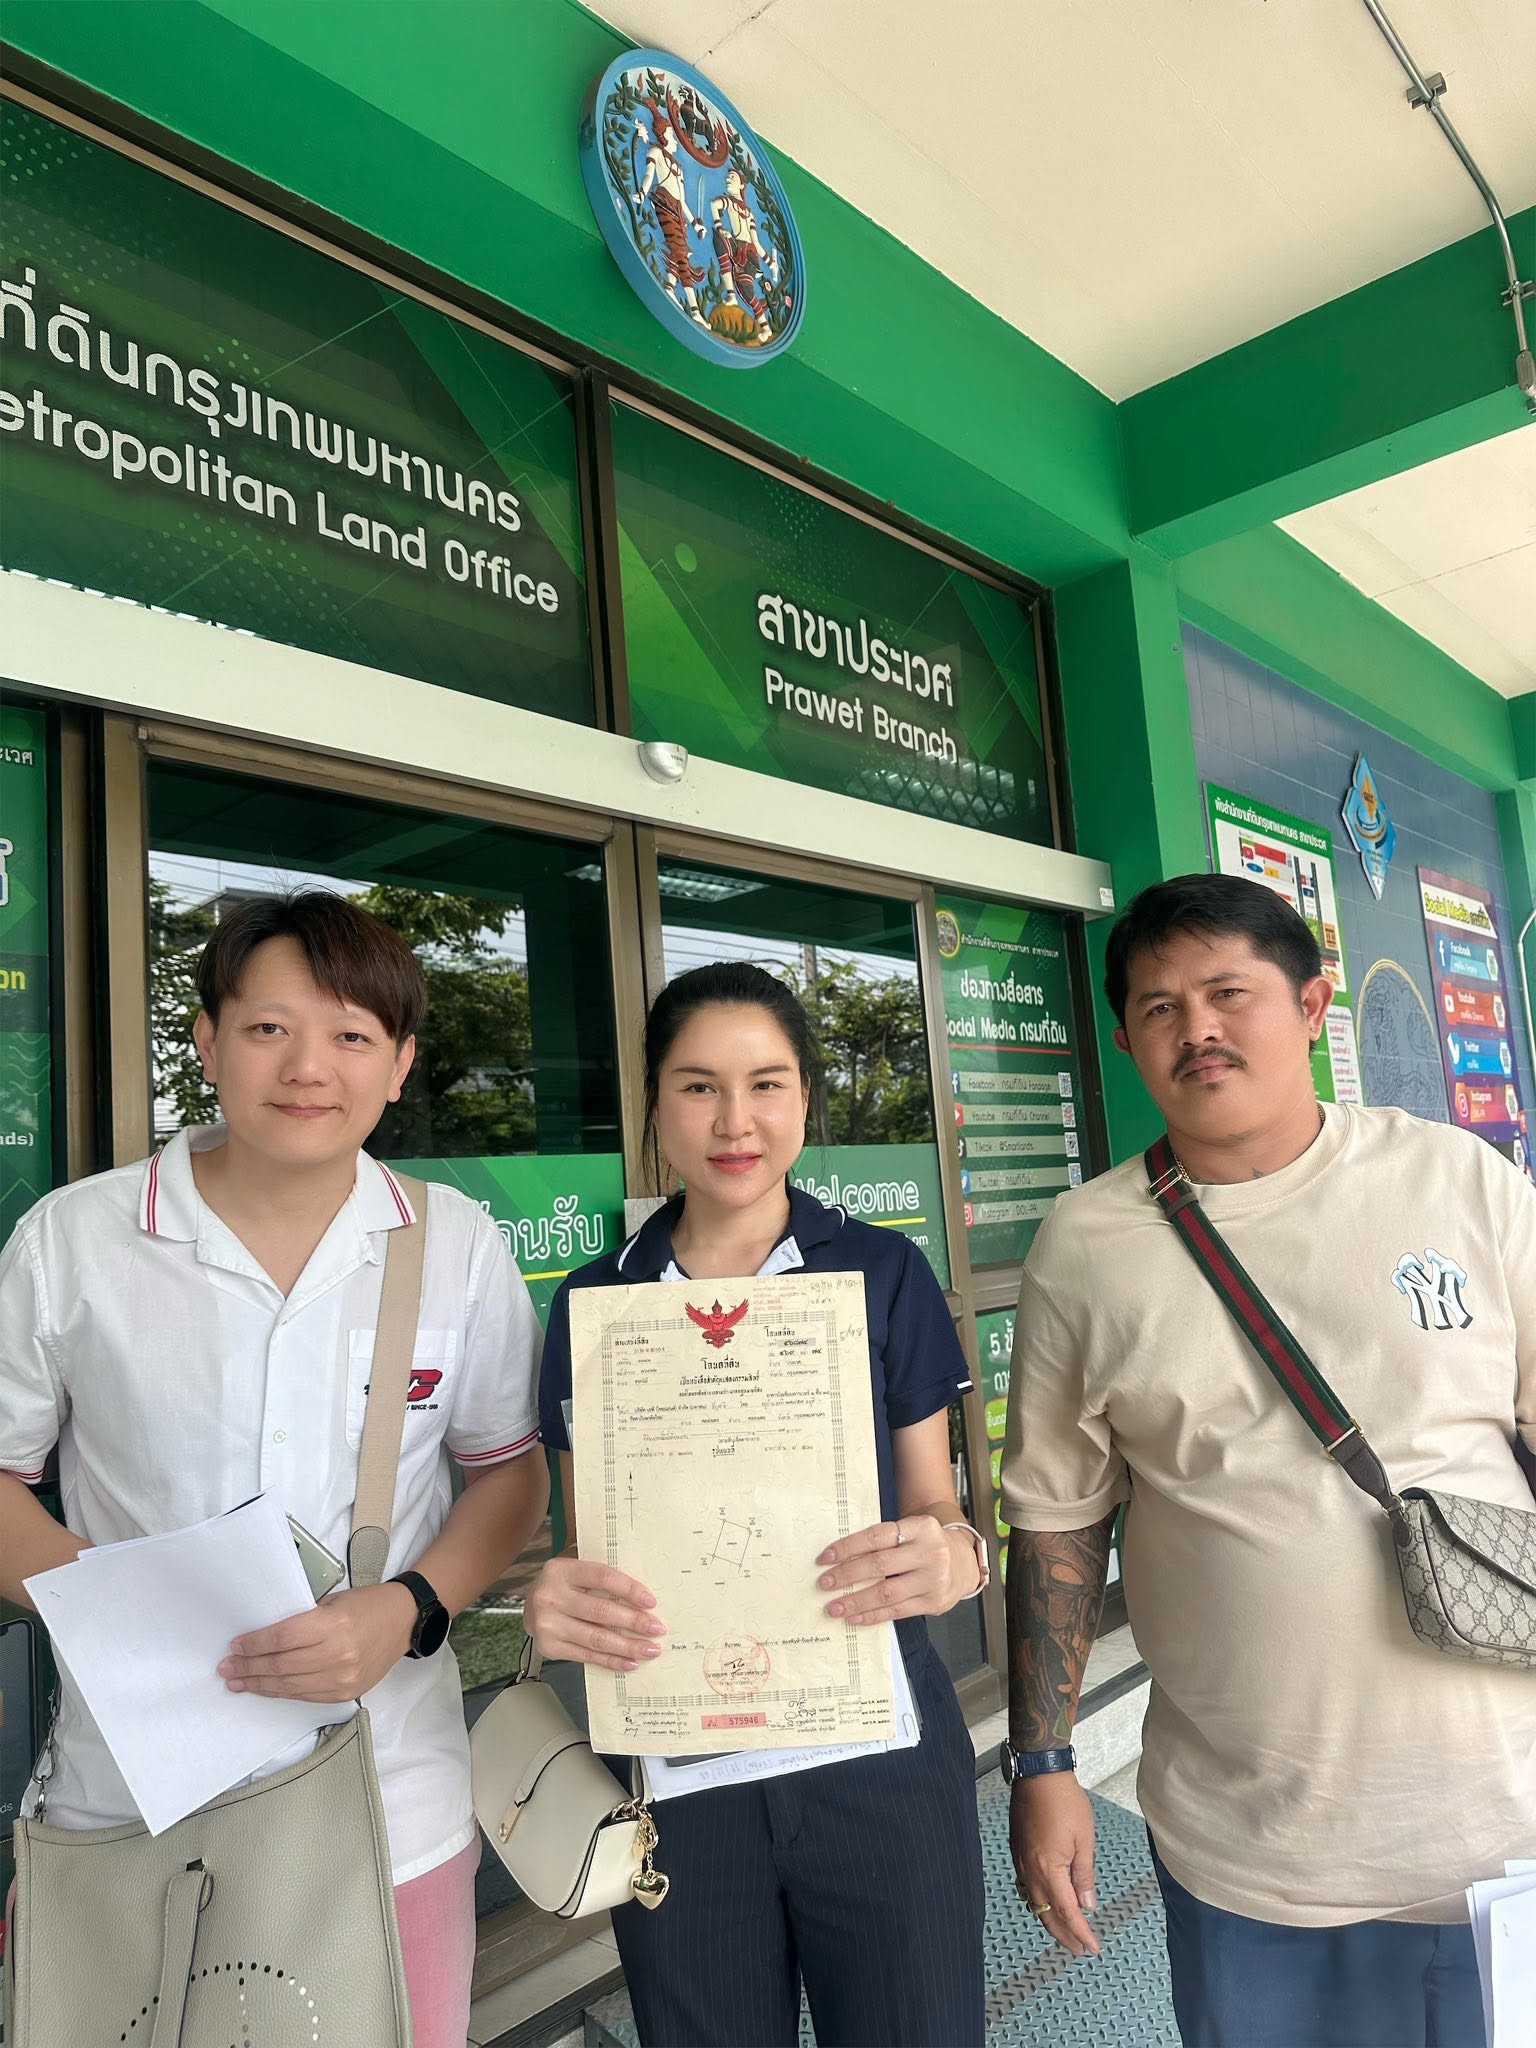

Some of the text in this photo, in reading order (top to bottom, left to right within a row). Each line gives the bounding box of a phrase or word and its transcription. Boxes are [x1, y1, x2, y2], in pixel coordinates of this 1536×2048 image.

[317, 491, 428, 570] Land
[443, 538, 560, 614] Office
[757, 593, 954, 707] สาขาประเวศ
[764, 668, 957, 763] Prawet Branch
[1424, 892, 1447, 918] Social
[1447, 899, 1470, 924] Media
[1450, 941, 1471, 957] Facebook
[960, 970, 1044, 1006] ช่องทางสื่อสาร
[1457, 991, 1476, 1005] Youtube
[981, 1016, 1017, 1041] Media
[1020, 1012, 1068, 1045] กรมที่ดิน
[968, 1078, 995, 1089] Facebook
[972, 1111, 996, 1121] Youtube
[990, 1332, 1001, 1356] 5
[700, 1354, 740, 1370] โฉนดที่ดิน
[729, 1716, 759, 1726] 575946
